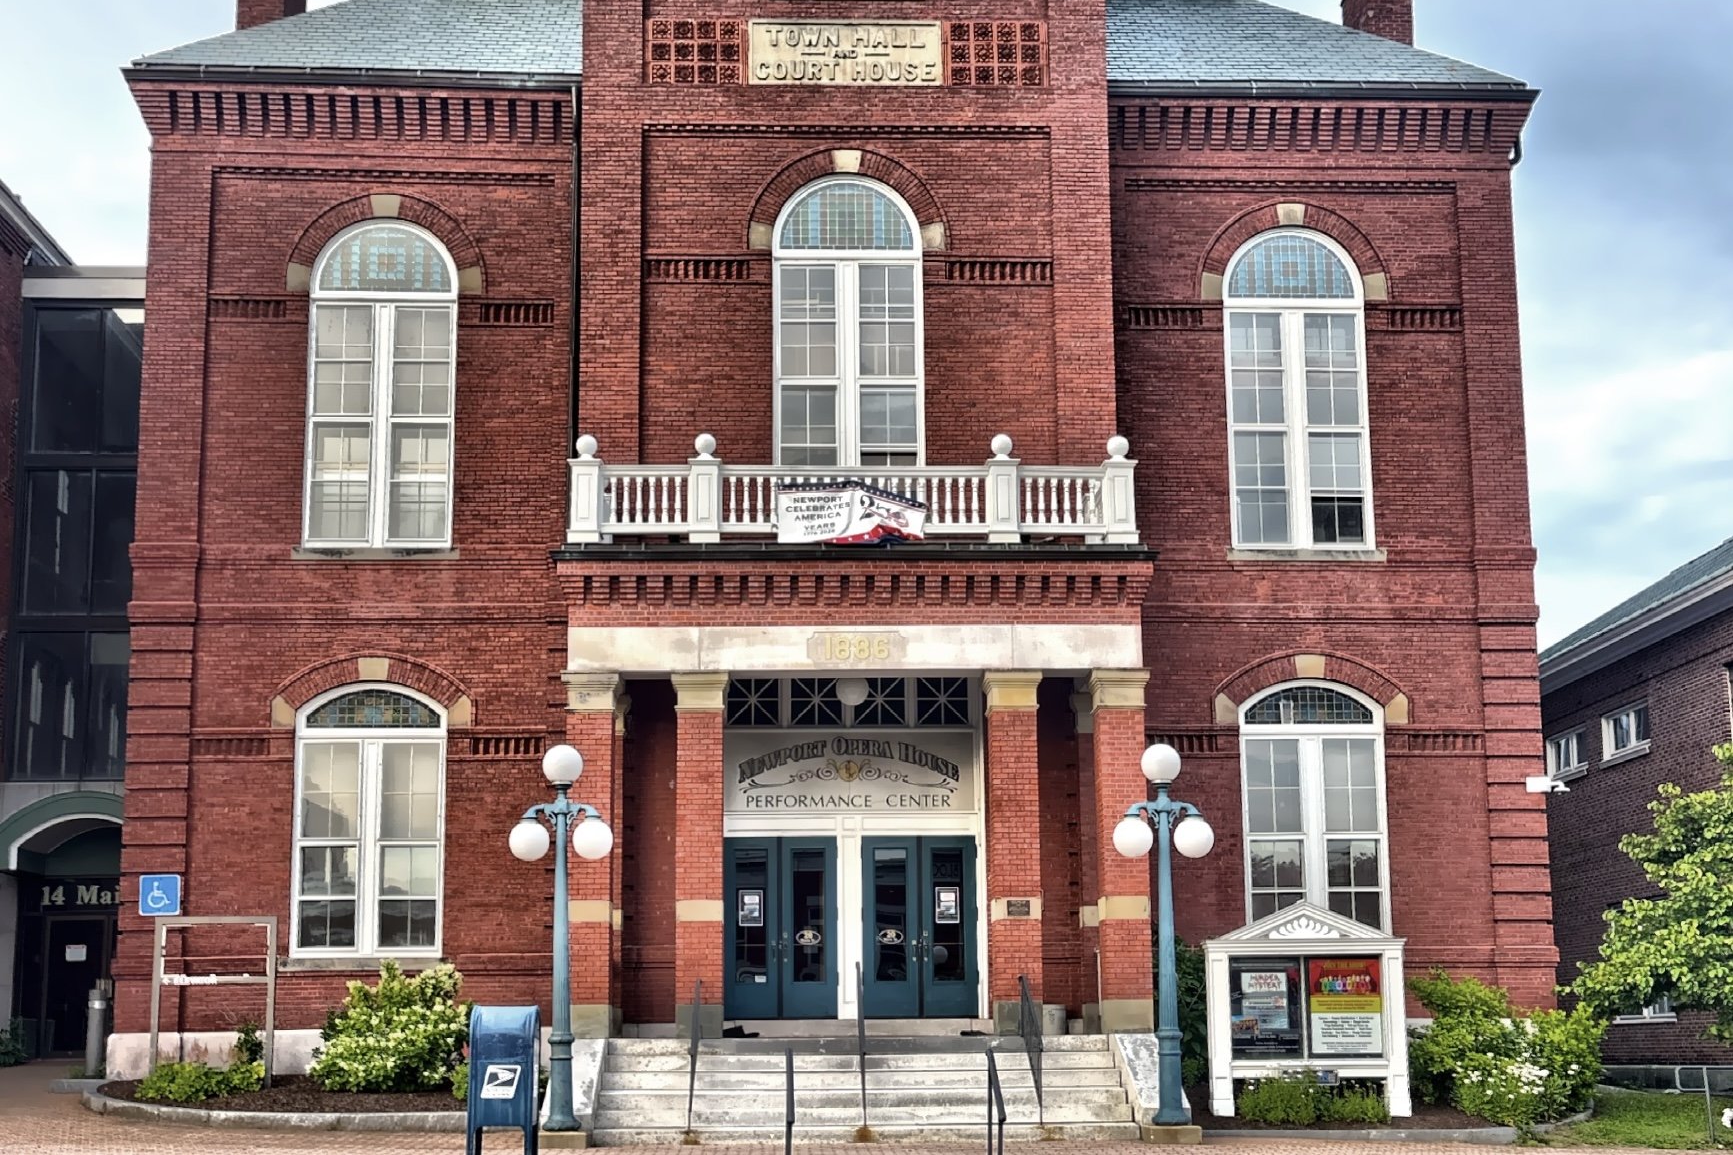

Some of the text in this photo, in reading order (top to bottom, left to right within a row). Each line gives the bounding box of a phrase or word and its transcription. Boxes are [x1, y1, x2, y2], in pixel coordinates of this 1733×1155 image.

[766, 27, 926, 49] TOWN HALL
[833, 50, 858, 59] AND
[755, 61, 937, 82] COURT HOUSE
[793, 496, 843, 504] NEWPORT
[786, 502, 850, 512] CELEBRATES
[795, 512, 841, 521] AMERICA
[804, 522, 836, 530] YEARS
[825, 636, 889, 660] 1886
[738, 736, 960, 784] NEWPORT OPERA HOUSE
[746, 795, 951, 808] PERFORMANCE CENTER
[41, 885, 66, 905] 14
